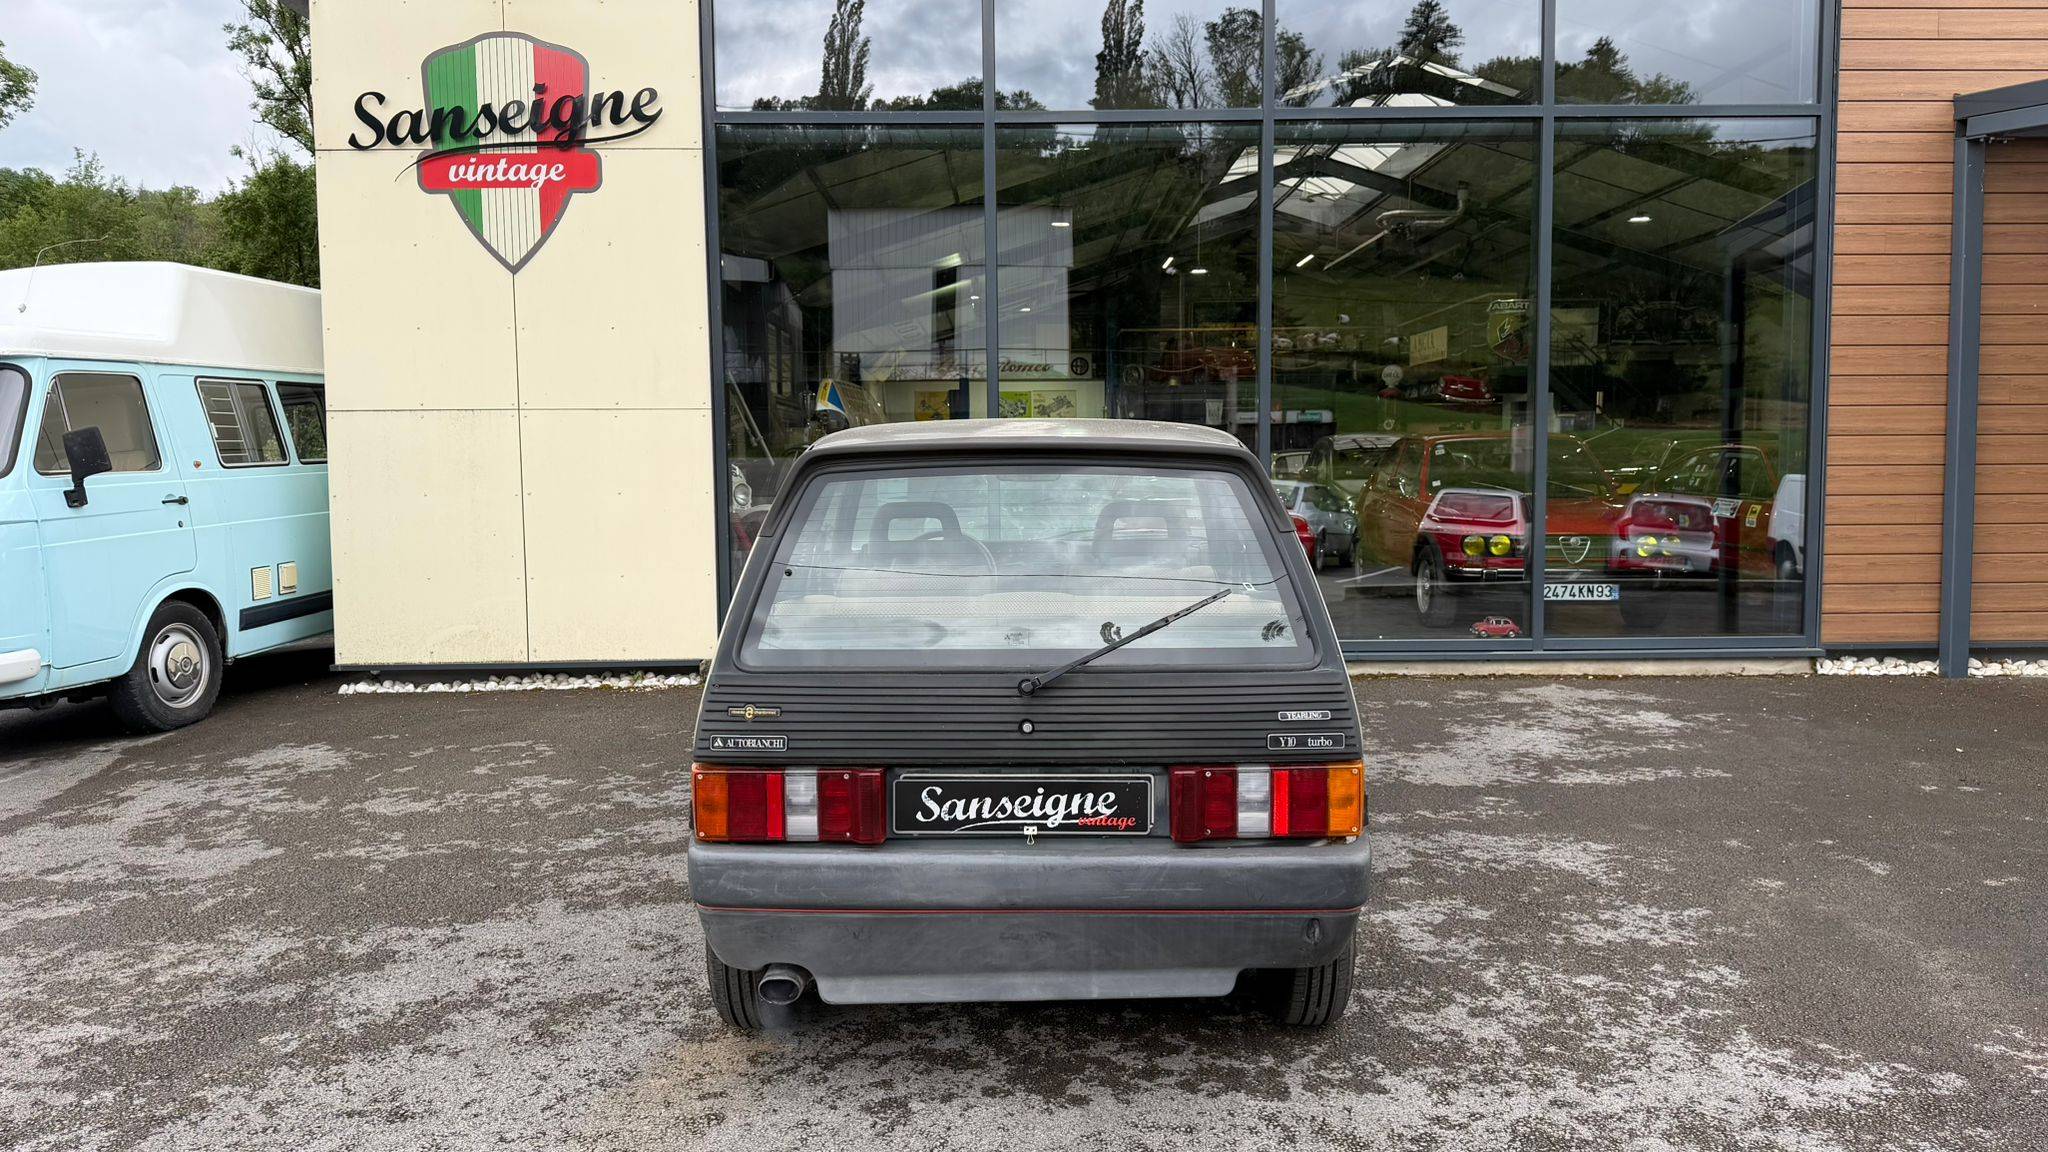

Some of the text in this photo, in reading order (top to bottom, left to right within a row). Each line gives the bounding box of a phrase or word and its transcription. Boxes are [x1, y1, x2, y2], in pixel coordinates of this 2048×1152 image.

[348, 83, 664, 151] Sanseigne
[448, 156, 567, 189] vintage
[1491, 302, 1530, 311] ABART
[1544, 584, 1613, 599] 2474KN93
[725, 738, 784, 749] AUTOBIANCHI
[1278, 736, 1333, 748] Y10 turbo
[916, 785, 1118, 828] Sanseigne
[1078, 813, 1137, 830] vintage
